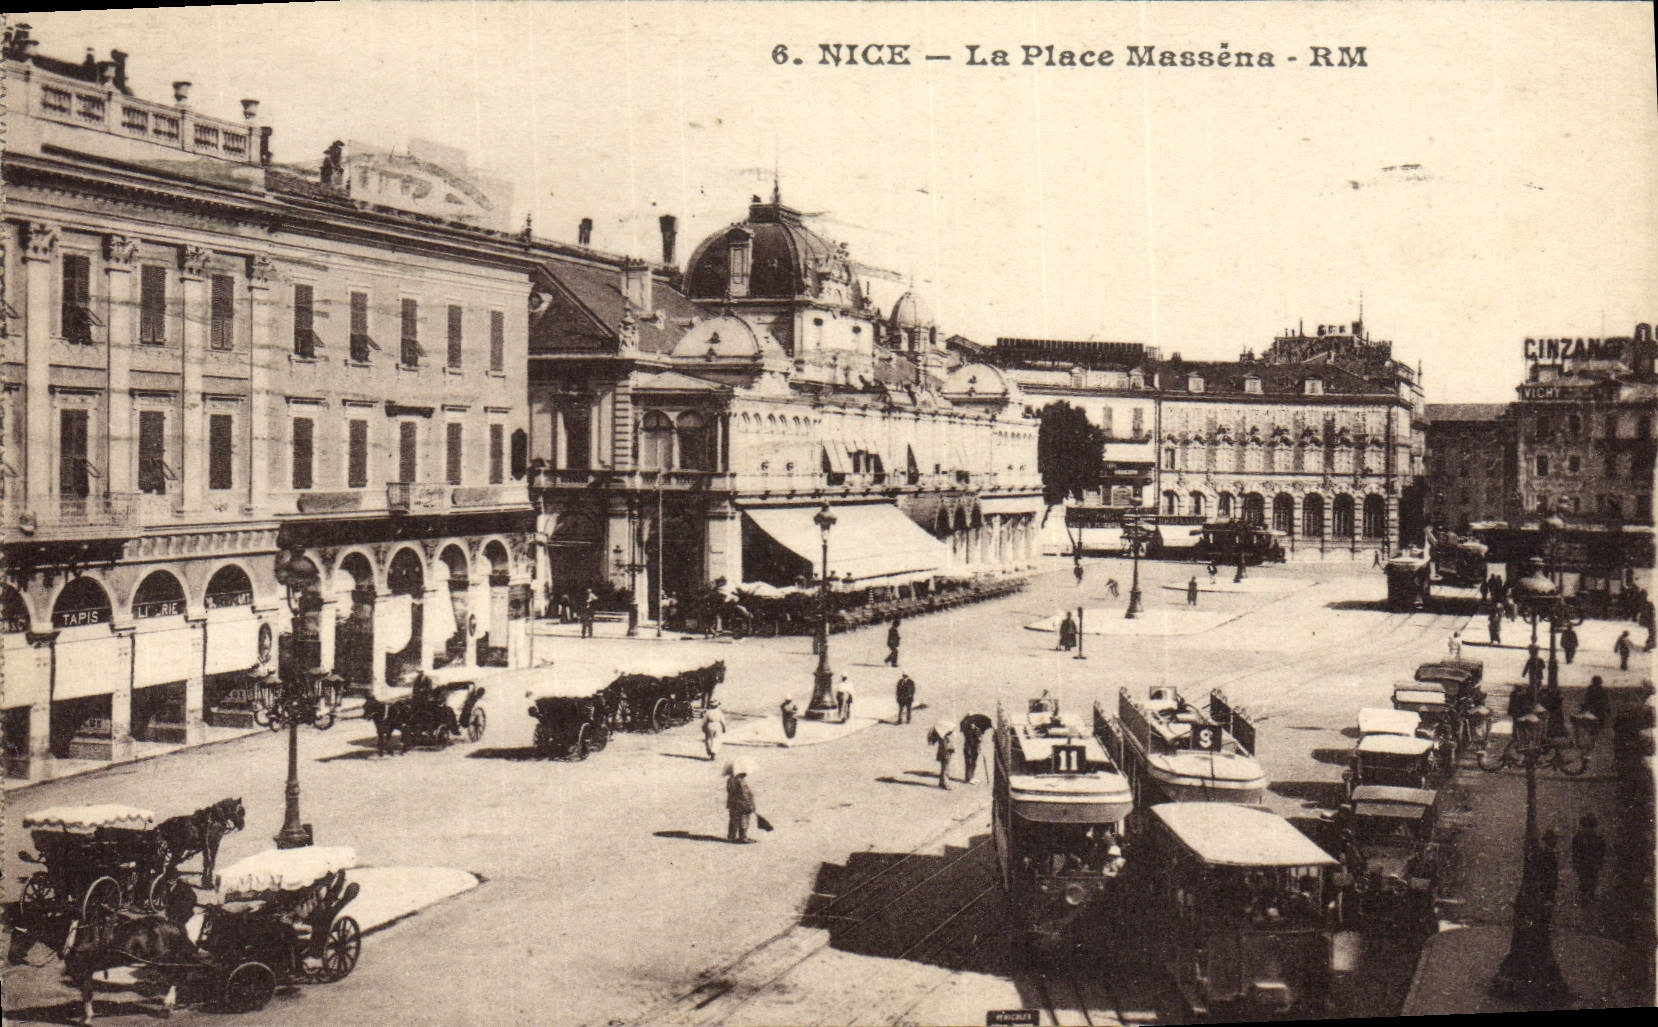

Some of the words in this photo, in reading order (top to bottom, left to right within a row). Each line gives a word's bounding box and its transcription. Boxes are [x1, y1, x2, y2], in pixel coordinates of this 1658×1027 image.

[138, 602, 179, 618] LIRIE
[63, 611, 99, 626] TAPIS
[1058, 749, 1078, 772] 11
